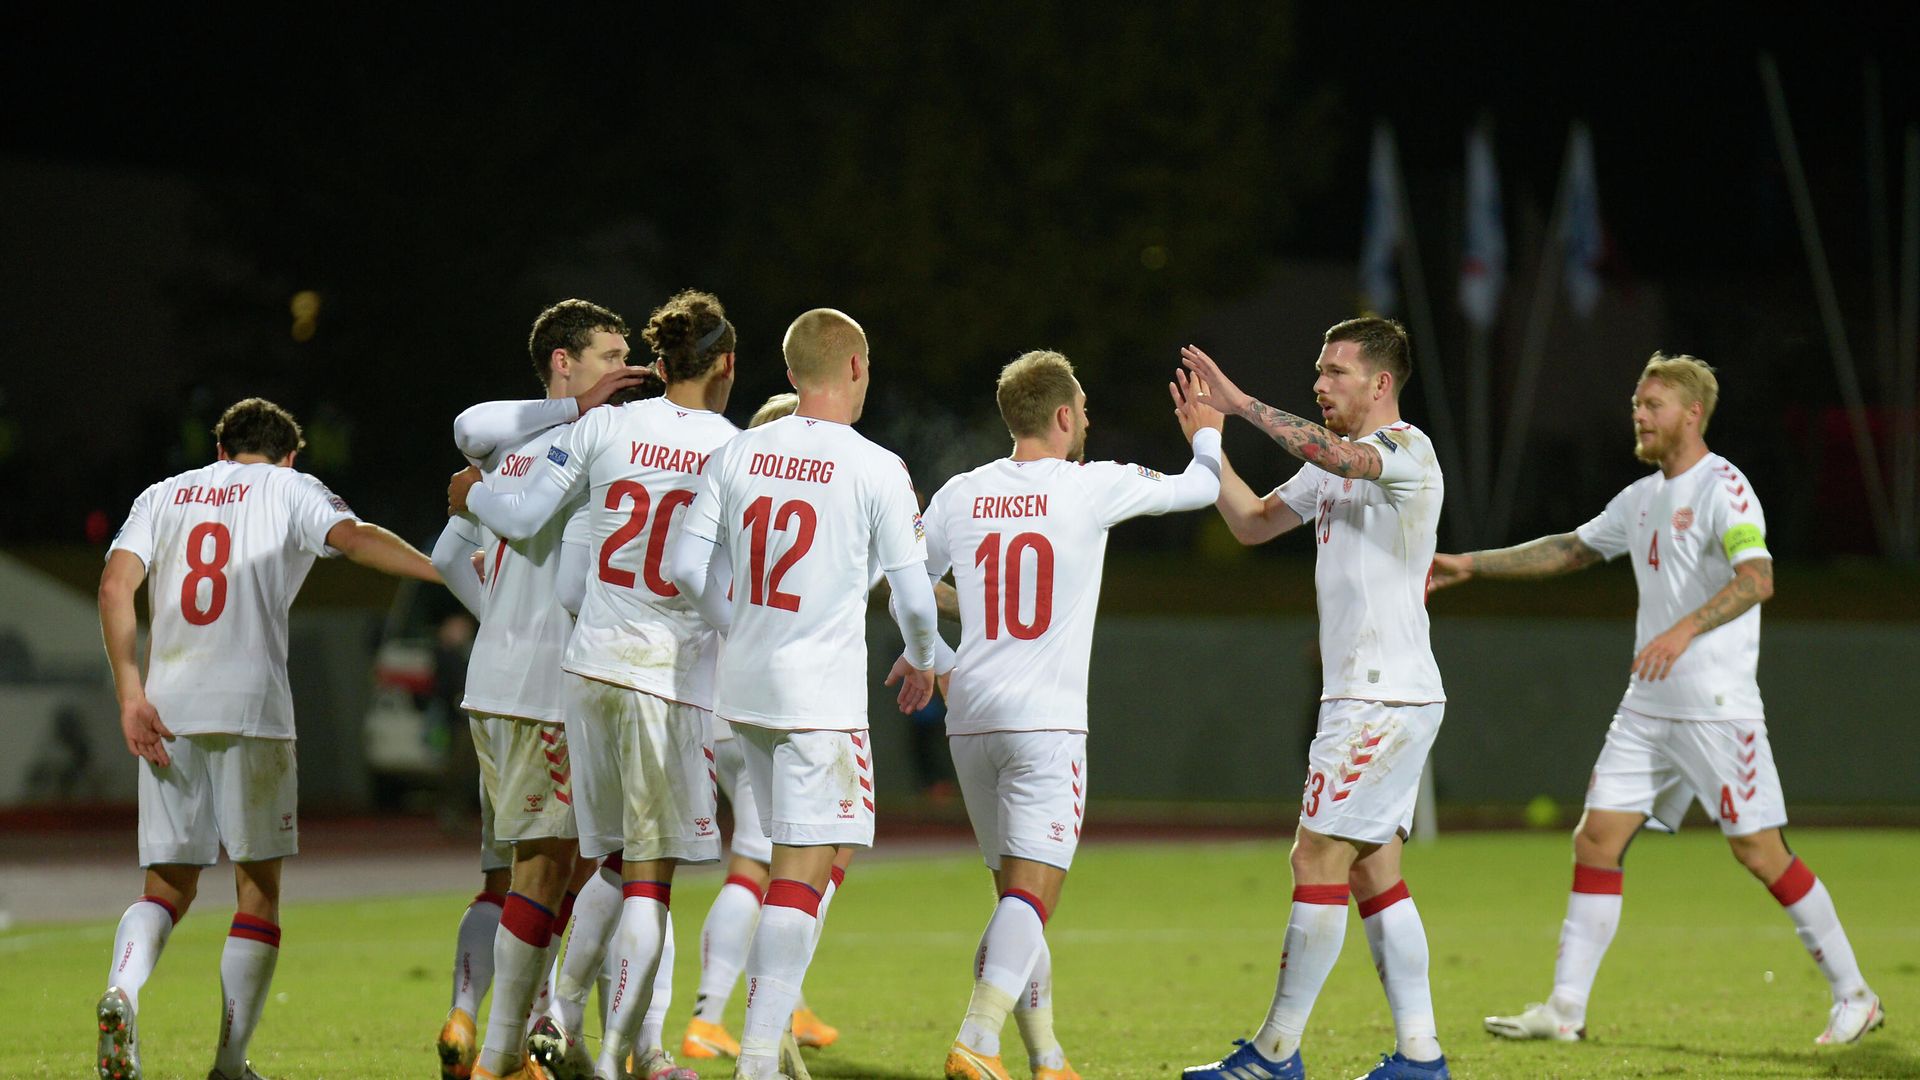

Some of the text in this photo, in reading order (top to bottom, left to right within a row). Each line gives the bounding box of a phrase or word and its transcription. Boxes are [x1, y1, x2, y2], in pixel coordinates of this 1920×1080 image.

[629, 440, 711, 476] YURARY
[749, 452, 836, 485] DOLBERG
[174, 483, 250, 507] DELANEY
[972, 494, 1048, 520] ERIKSEN
[743, 495, 818, 613] 12
[1648, 528, 1661, 572] 4
[180, 521, 232, 627] 8
[975, 531, 1055, 641] 10
[1720, 785, 1739, 824] 4
[612, 958, 628, 1014] DANMARK
